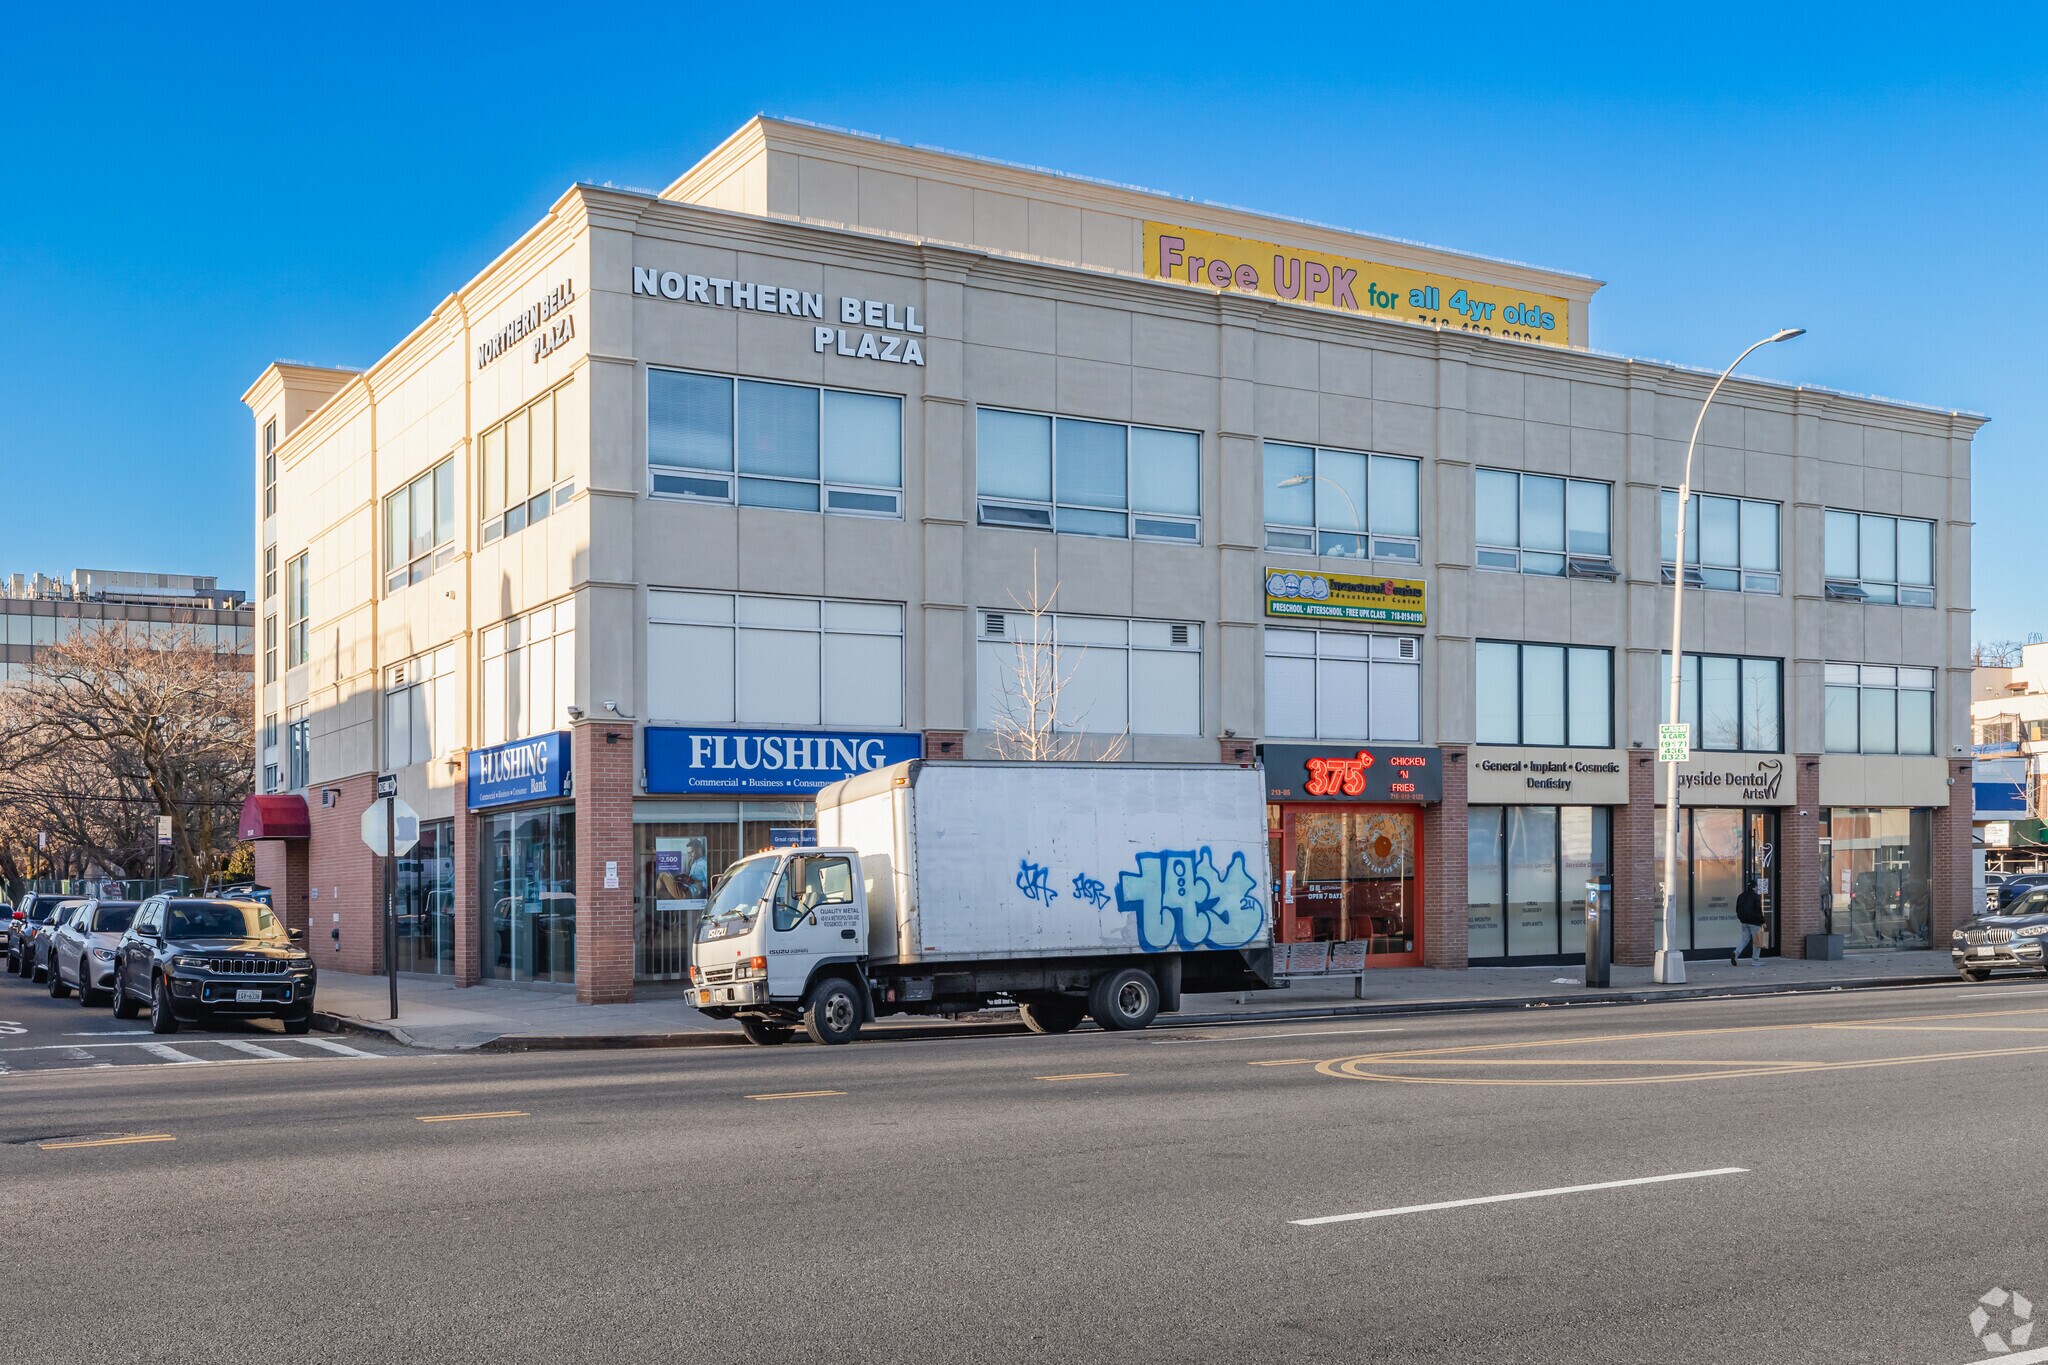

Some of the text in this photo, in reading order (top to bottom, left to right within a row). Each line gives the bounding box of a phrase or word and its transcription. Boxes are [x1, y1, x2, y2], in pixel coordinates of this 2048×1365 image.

[1159, 235, 1556, 330] Free UPK for all 4yr olds
[633, 266, 925, 334] NORTHERN BELL
[478, 278, 575, 370] NORTHERN BELL
[532, 314, 575, 364] PLAZA
[814, 326, 925, 367] PLAZA
[1272, 603, 1304, 613] PRESCHOOL
[1306, 605, 1343, 616] AFTERSCHOOL
[1345, 608, 1358, 617] FREE
[1359, 609, 1370, 618] UPK
[1370, 610, 1386, 619] CLASS
[689, 735, 886, 771] FLUSHING
[480, 741, 548, 785] FLUSHING
[1390, 757, 1426, 767] CHICKEN
[1482, 760, 1620, 774] General Implant Cosmetic
[530, 776, 547, 793] Bank
[689, 777, 739, 788] Commercial
[749, 778, 784, 788] Business
[1391, 783, 1415, 792] FRIES
[1526, 777, 1571, 791] Dentistry
[1678, 771, 1767, 788] ayside Dental
[1743, 788, 1764, 799] Arts
[1590, 891, 1597, 900] P
[708, 927, 727, 938] ISUZU
